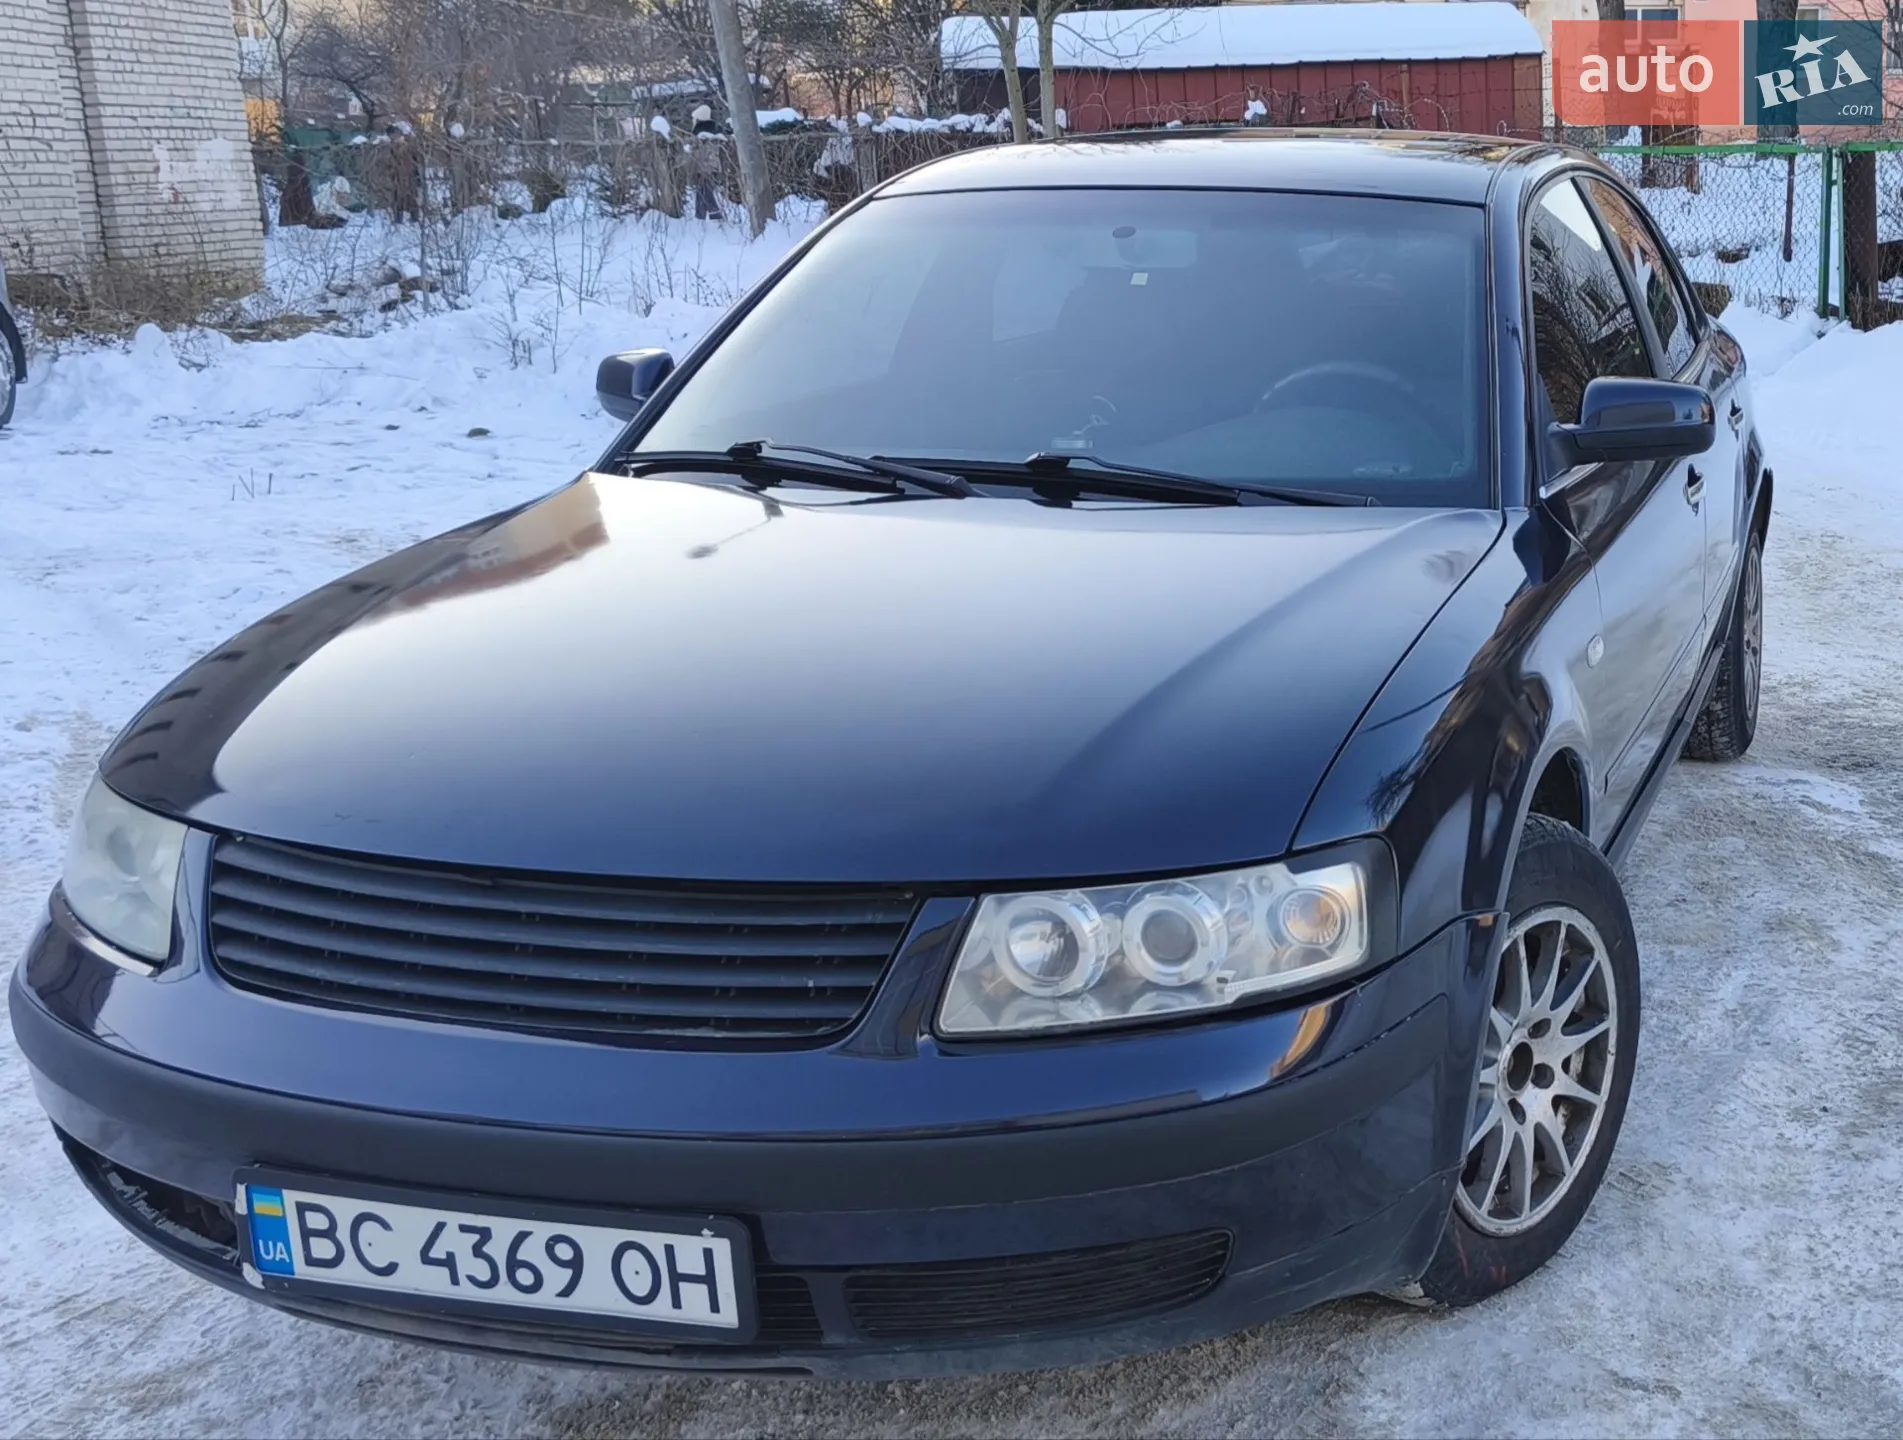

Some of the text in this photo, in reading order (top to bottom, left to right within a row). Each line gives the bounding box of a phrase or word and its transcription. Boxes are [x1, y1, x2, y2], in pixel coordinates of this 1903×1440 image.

[259, 1239, 290, 1263] UA
[295, 1201, 720, 1314] BC 4369 OH
